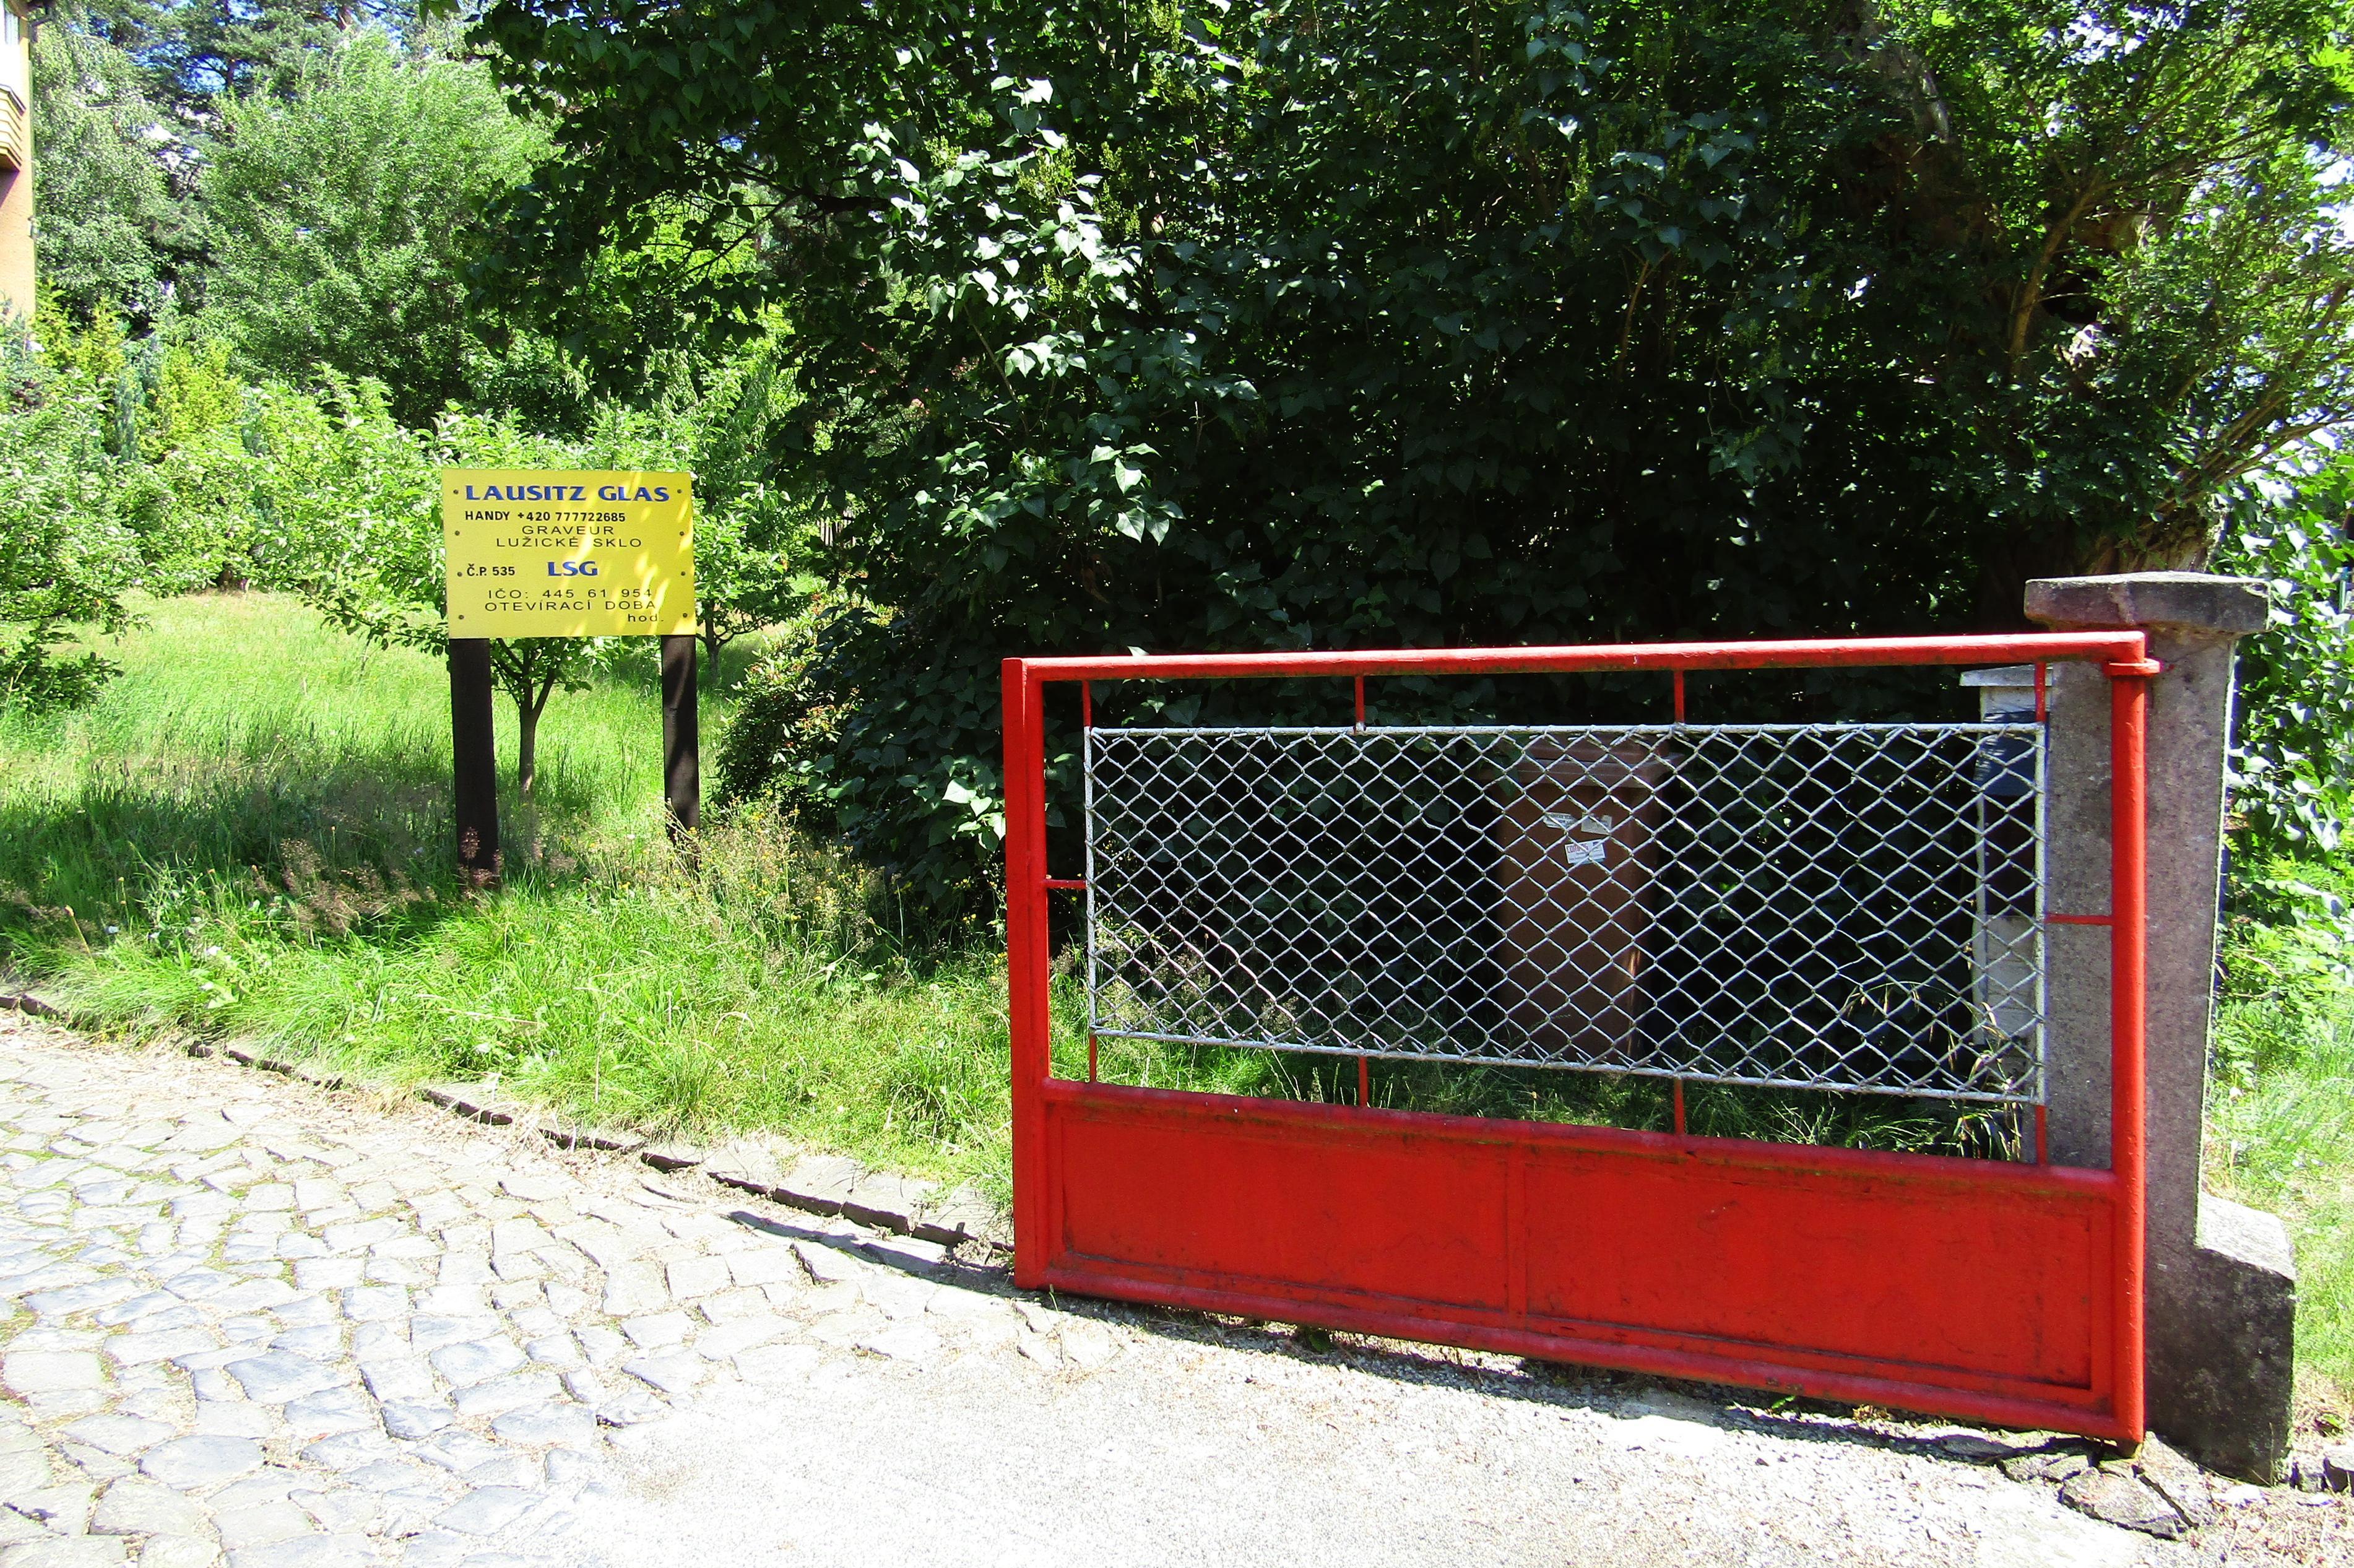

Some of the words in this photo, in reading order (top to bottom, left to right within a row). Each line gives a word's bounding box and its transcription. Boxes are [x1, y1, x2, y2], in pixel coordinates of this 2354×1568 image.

[465, 485, 587, 501] LAUSITZ
[598, 485, 670, 501] GLAS
[465, 511, 510, 521] HANDY
[517, 511, 550, 521] +420
[555, 512, 626, 522] 777722685
[522, 526, 614, 535] GRAVEUR
[496, 536, 579, 547] LUŽICKÉ
[593, 538, 641, 547] SKLO
[467, 563, 487, 576] Č.P.
[492, 566, 515, 576] 535
[548, 561, 598, 576] LSG
[488, 587, 528, 599] IČO:
[542, 589, 574, 598] 445
[588, 589, 606, 598] 61
[621, 589, 652, 598] 954
[485, 599, 591, 611] OTEVÍRACÍ
[605, 600, 656, 610] DOBA
[628, 613, 664, 622] hod.
